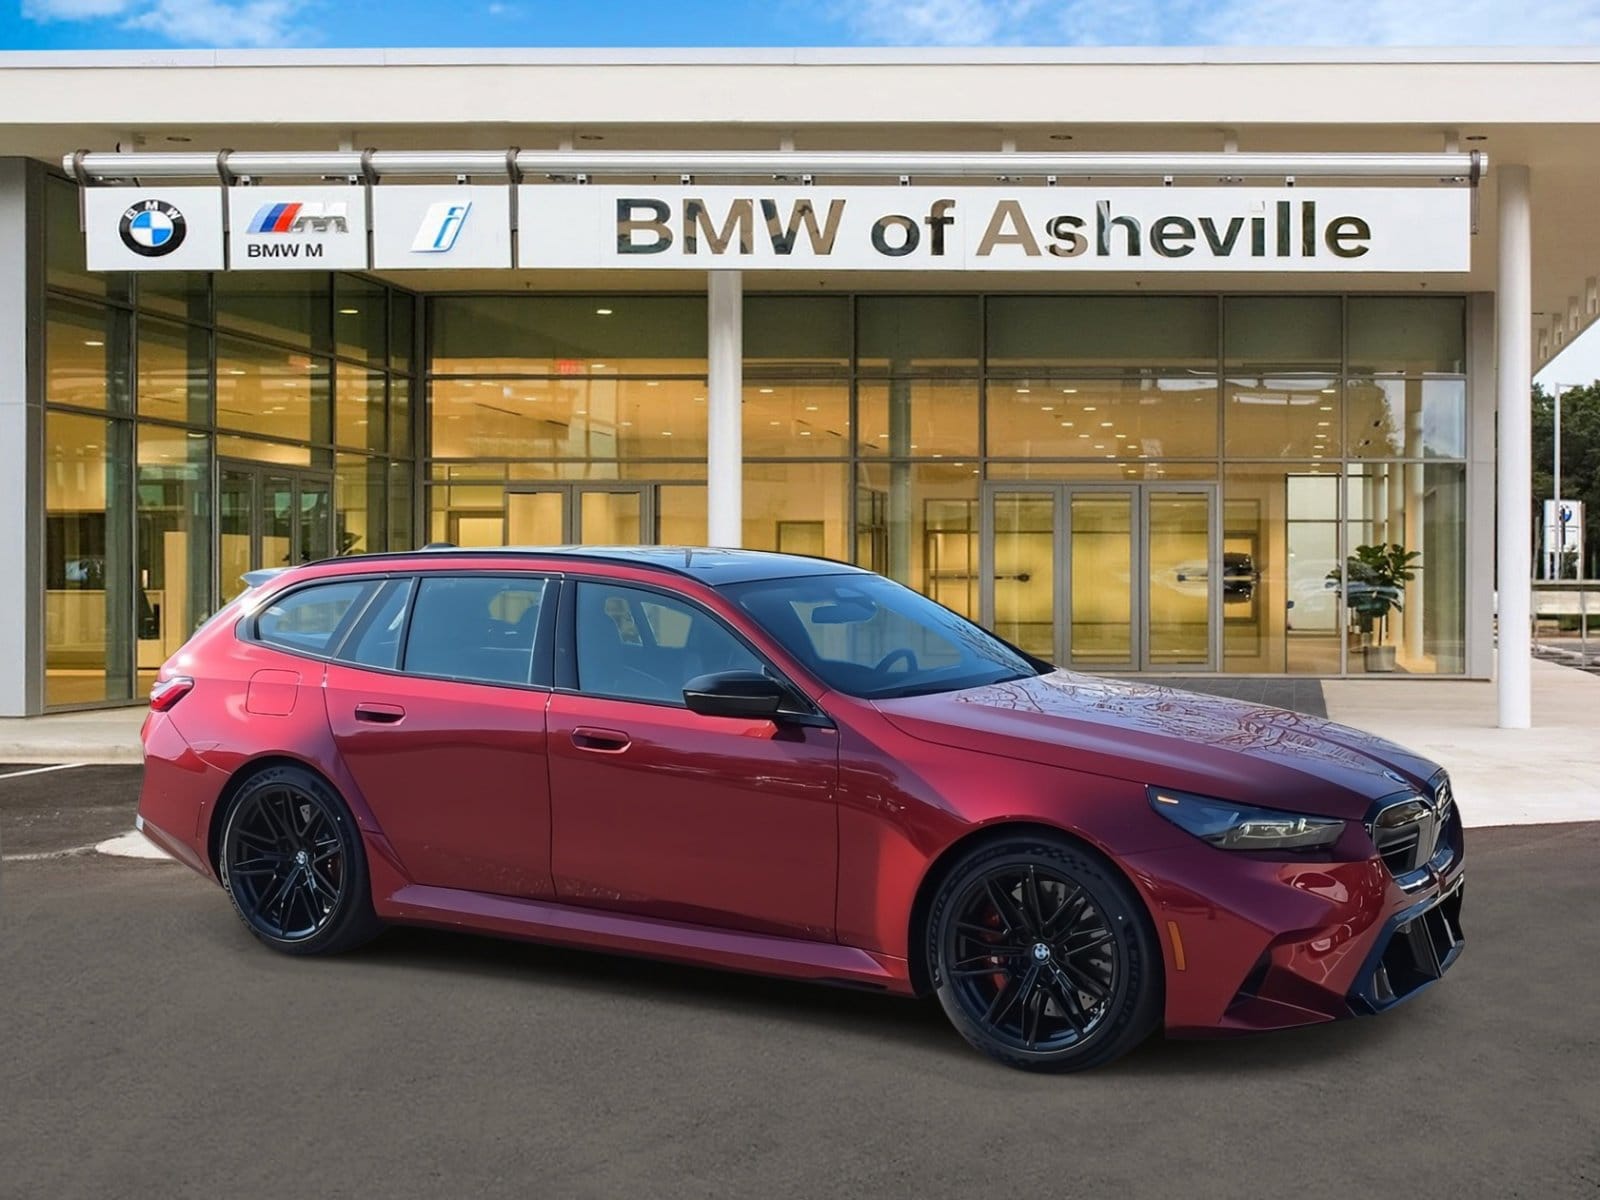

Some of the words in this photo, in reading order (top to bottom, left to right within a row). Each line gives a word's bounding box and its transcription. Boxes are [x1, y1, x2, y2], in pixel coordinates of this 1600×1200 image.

[125, 200, 182, 220] BMW
[616, 198, 846, 256] BMW
[871, 199, 956, 257] of
[975, 199, 1371, 258] Asheville
[247, 243, 300, 258] BMW
[305, 243, 323, 258] M
